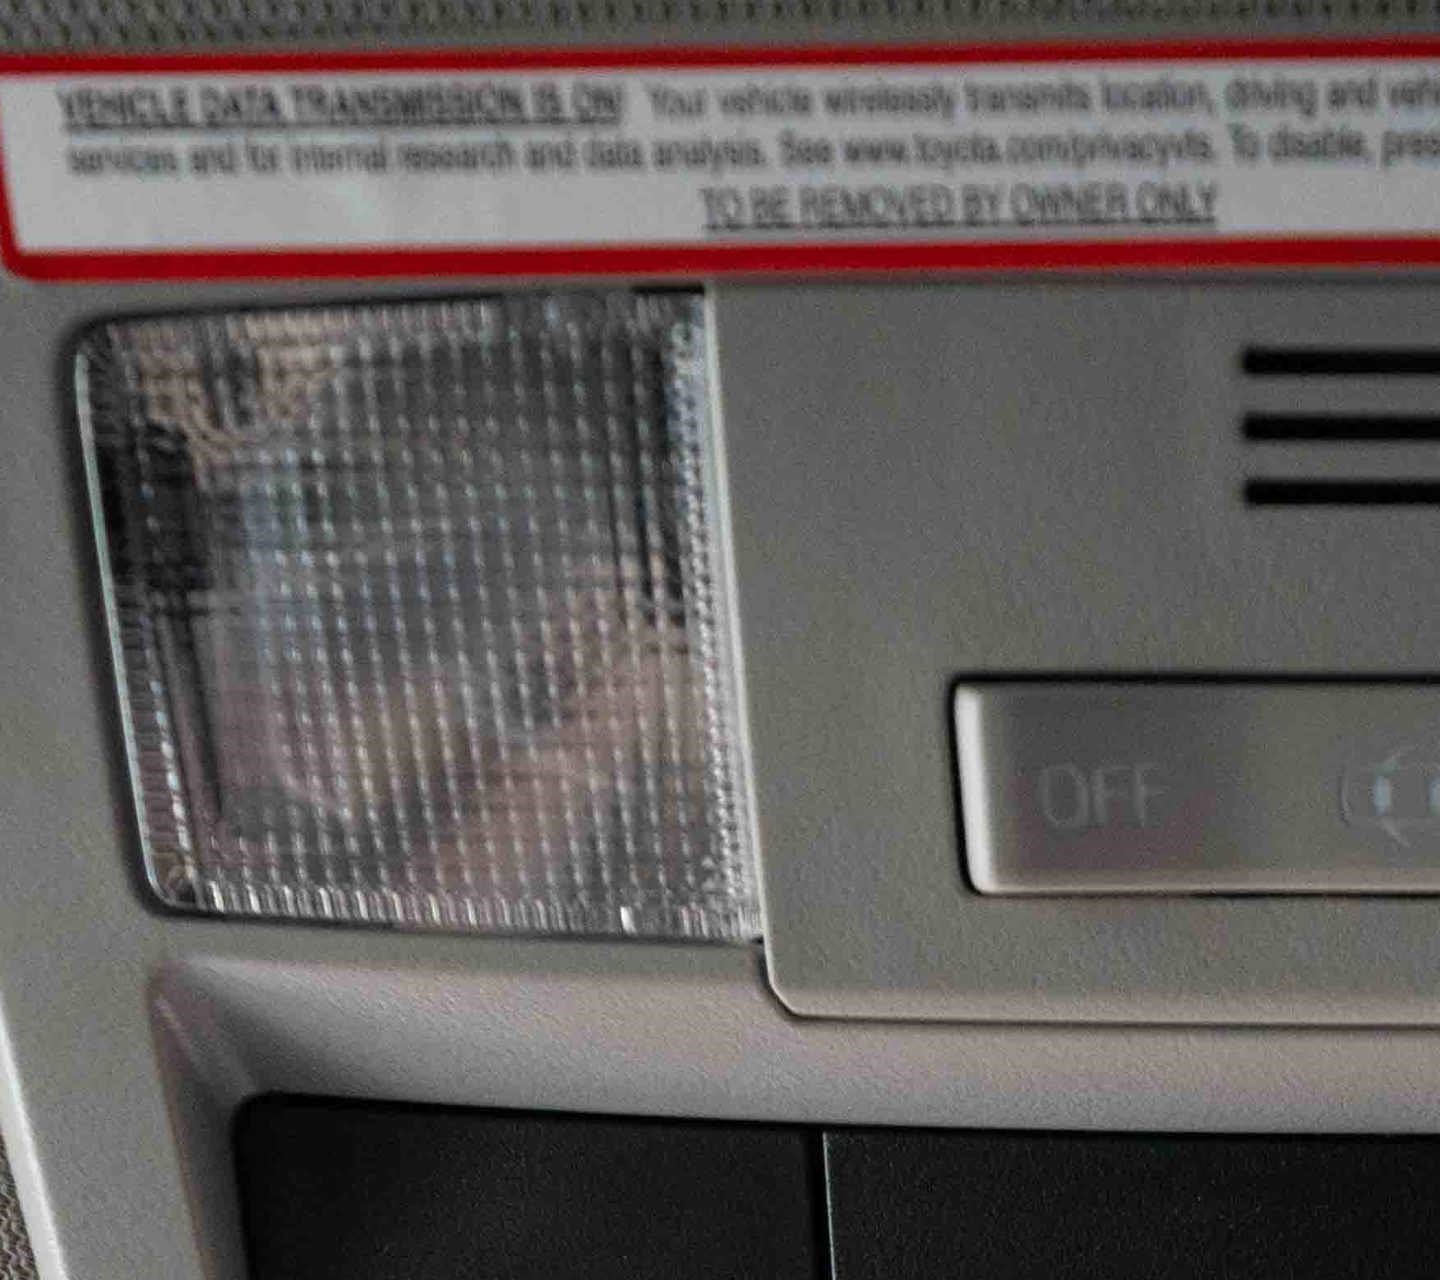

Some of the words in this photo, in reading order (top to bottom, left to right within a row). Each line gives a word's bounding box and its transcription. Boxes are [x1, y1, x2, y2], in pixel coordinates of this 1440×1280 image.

[59, 86, 191, 128] VEHICLE
[201, 85, 279, 125] DATA
[287, 82, 525, 124] TRANSMISSION
[646, 81, 707, 114] Your
[717, 80, 813, 114] vehicle
[822, 79, 953, 118] wirelessly
[963, 78, 1092, 112] transmits
[1223, 77, 1317, 116] driving
[1326, 77, 1378, 110] and
[68, 143, 180, 174] services
[191, 141, 236, 173] and
[244, 141, 281, 172] for
[292, 139, 388, 172] internal
[396, 138, 514, 171] research
[524, 137, 575, 169] and
[584, 135, 644, 169] data
[777, 130, 833, 168] See
[1227, 121, 1259, 161] To
[699, 186, 744, 225] TO
[750, 187, 791, 225] BE
[800, 185, 956, 223] REMOVED
[962, 184, 1003, 221] BY
[1009, 182, 1129, 220] OWNER
[1134, 181, 1219, 219] ONLY
[1037, 762, 1166, 830] OFF
